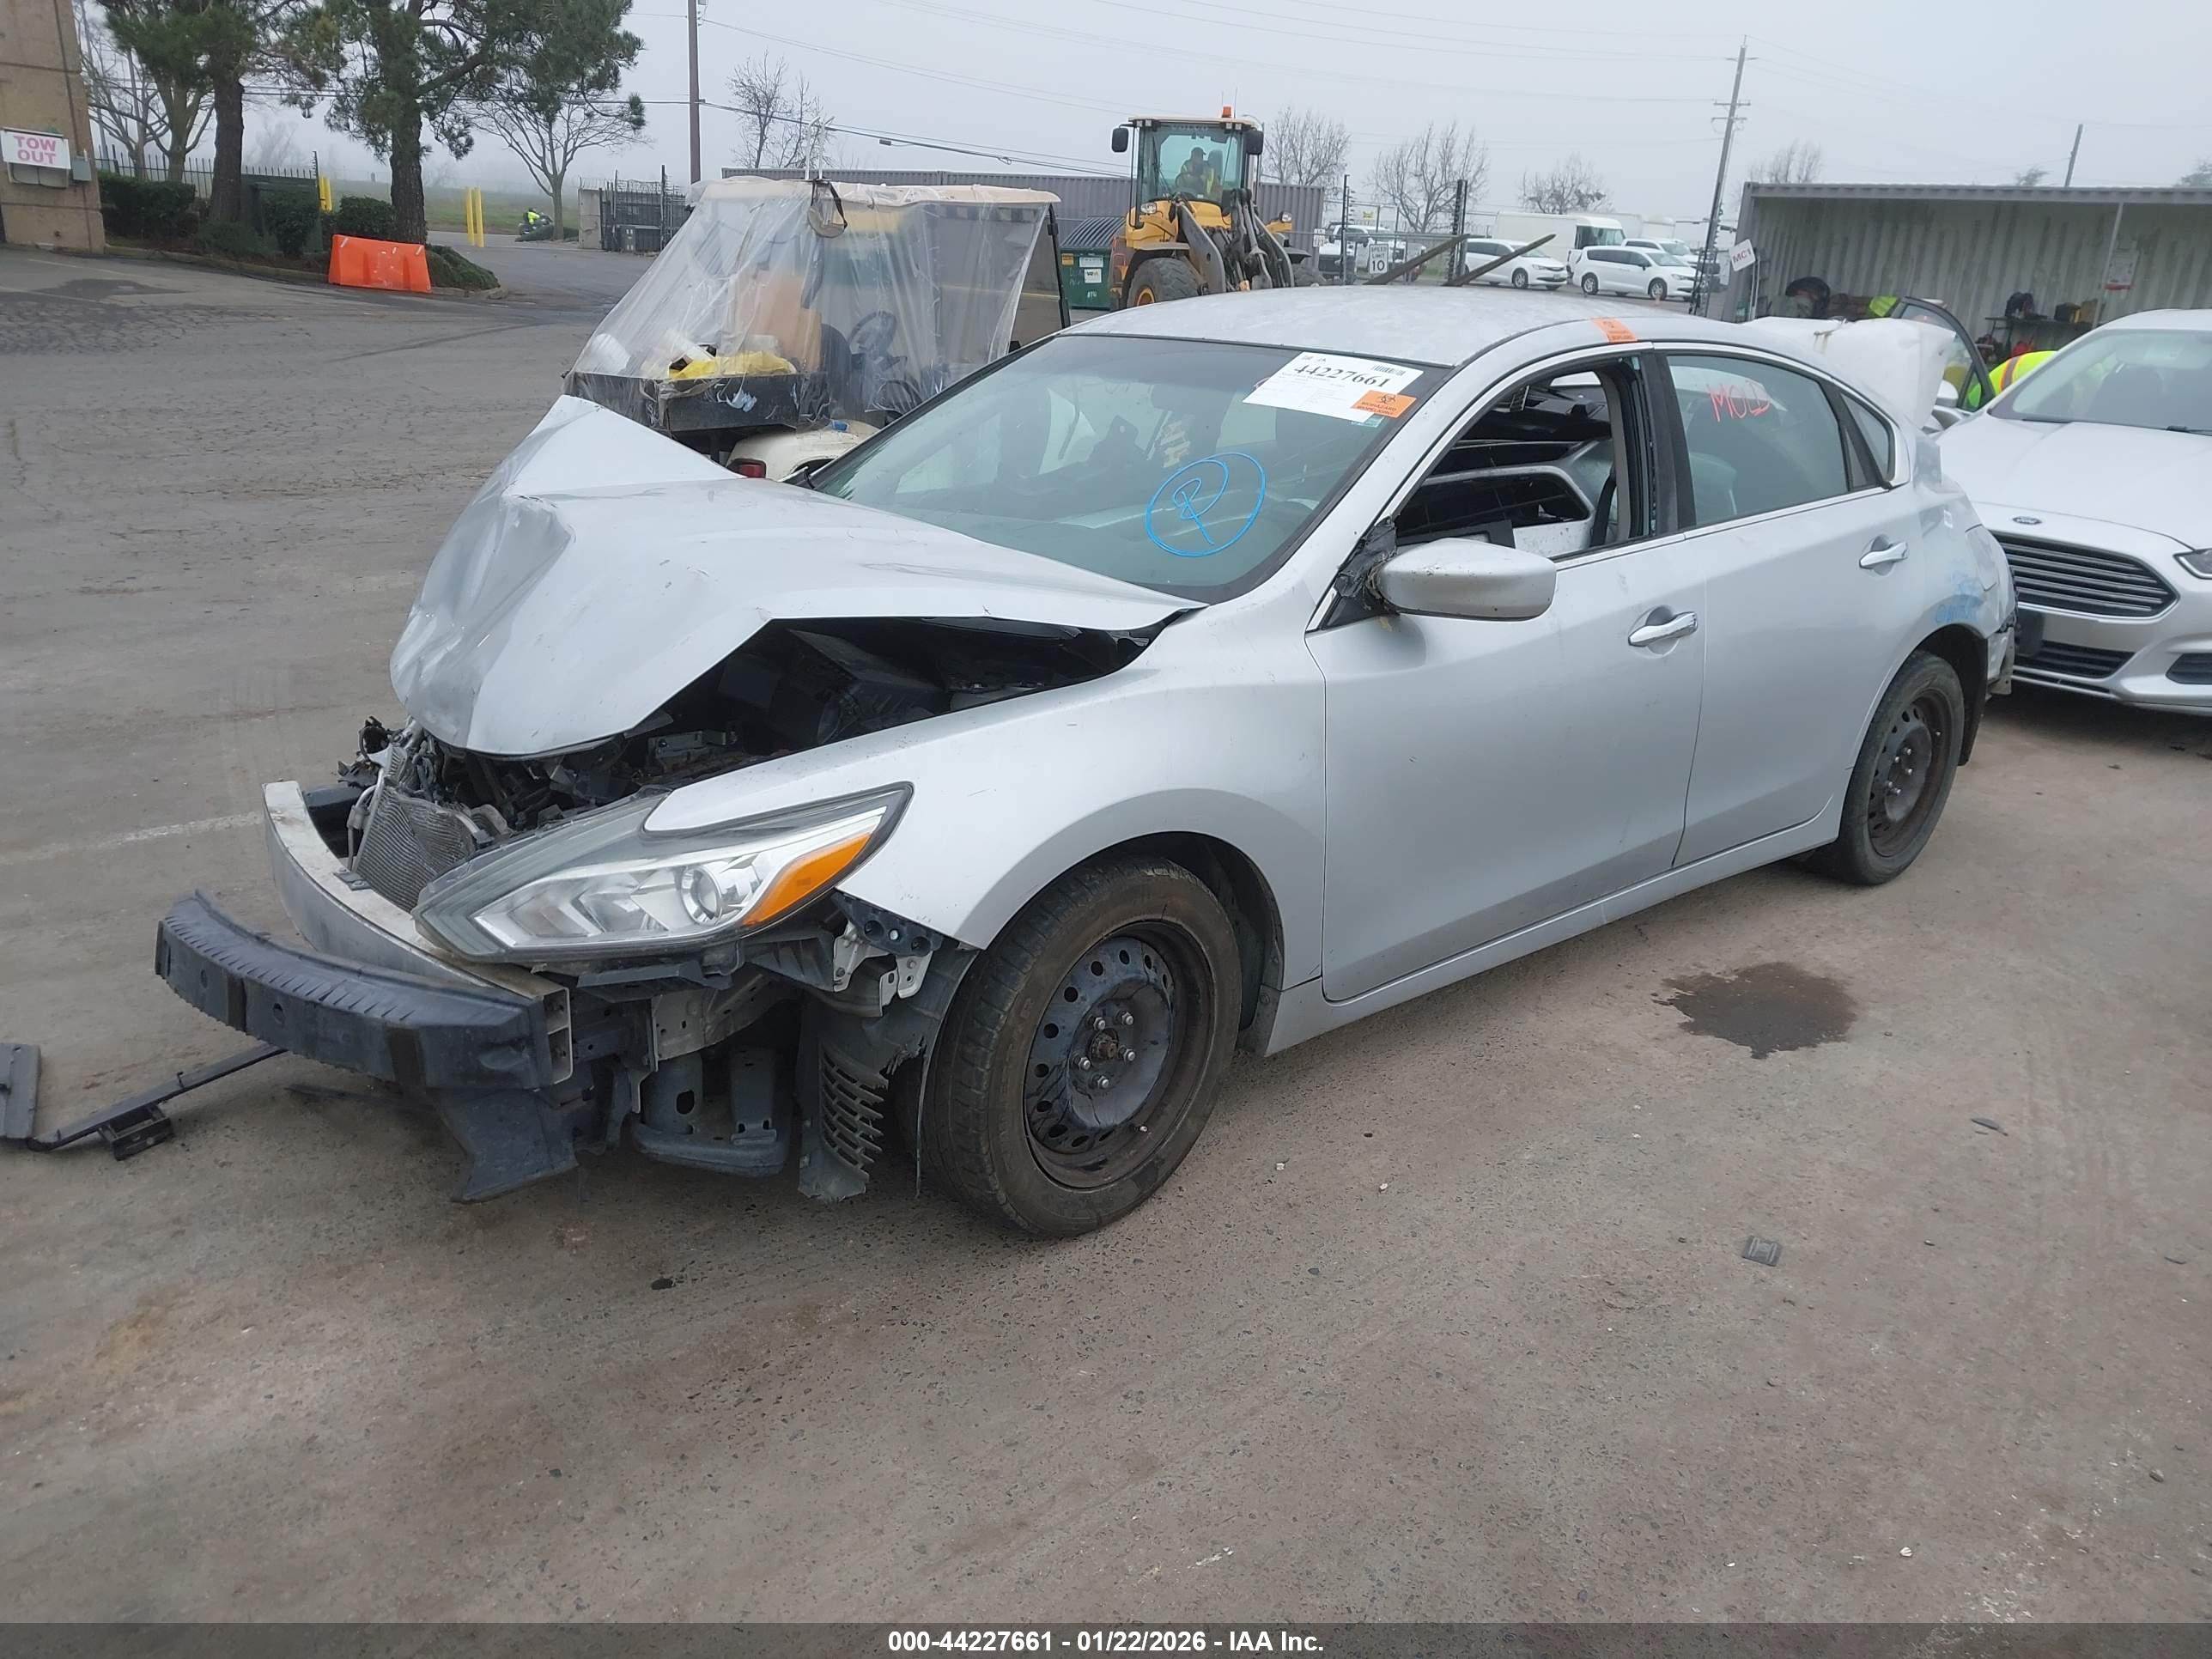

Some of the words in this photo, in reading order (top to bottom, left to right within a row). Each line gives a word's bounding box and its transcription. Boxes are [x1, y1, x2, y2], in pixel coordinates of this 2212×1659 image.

[13, 135, 56, 152] TOW
[17, 149, 57, 164] OUT
[1371, 259, 1385, 271] 10
[1294, 364, 1391, 388] 44227661
